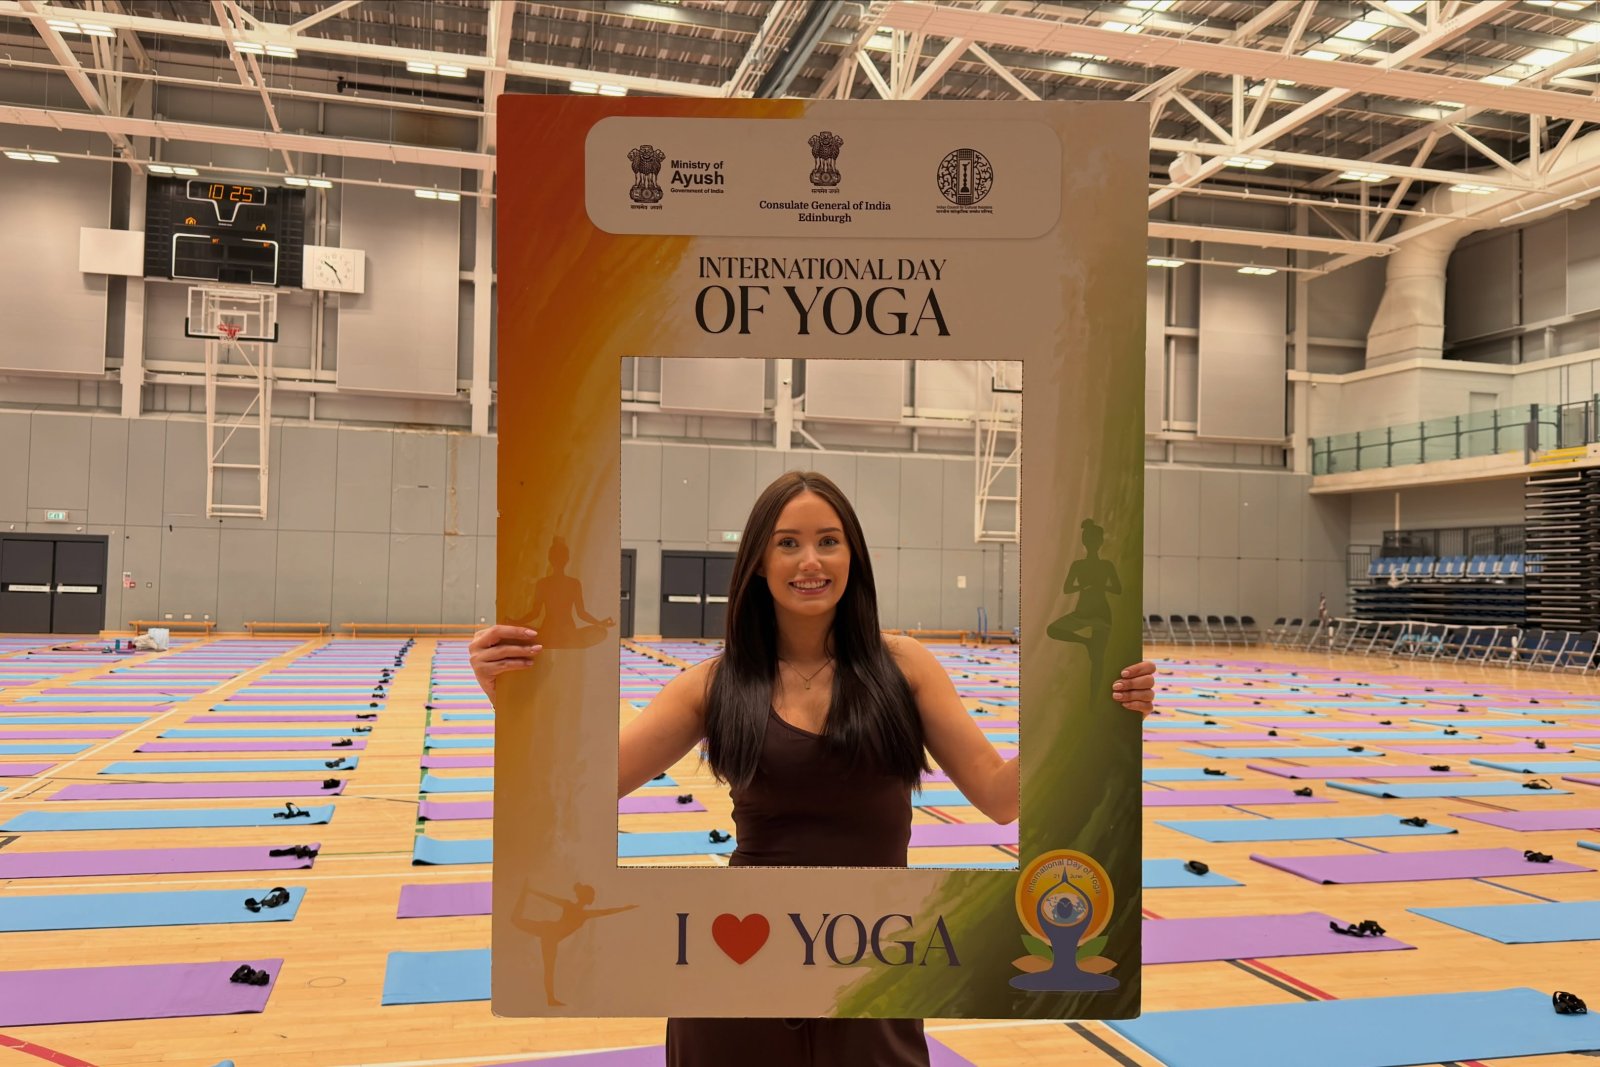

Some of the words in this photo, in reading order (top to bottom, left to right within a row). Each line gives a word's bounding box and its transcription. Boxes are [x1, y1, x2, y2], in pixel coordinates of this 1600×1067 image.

[671, 160, 710, 171] Ministry
[713, 161, 724, 169] of
[671, 170, 724, 188] Ayush
[759, 200, 809, 210] Consulate
[811, 201, 850, 210] General
[852, 201, 864, 210] of
[865, 201, 891, 210] India
[798, 213, 852, 223] Edinburgh
[699, 256, 893, 280] INTERNATIONAL
[898, 258, 947, 281] DAY
[695, 285, 771, 334] OF
[783, 286, 951, 336] YOGA
[1028, 859, 1064, 893] International
[1066, 859, 1082, 870] Day
[1083, 867, 1092, 875] of
[675, 913, 690, 965] I
[787, 913, 961, 967] YOGA
